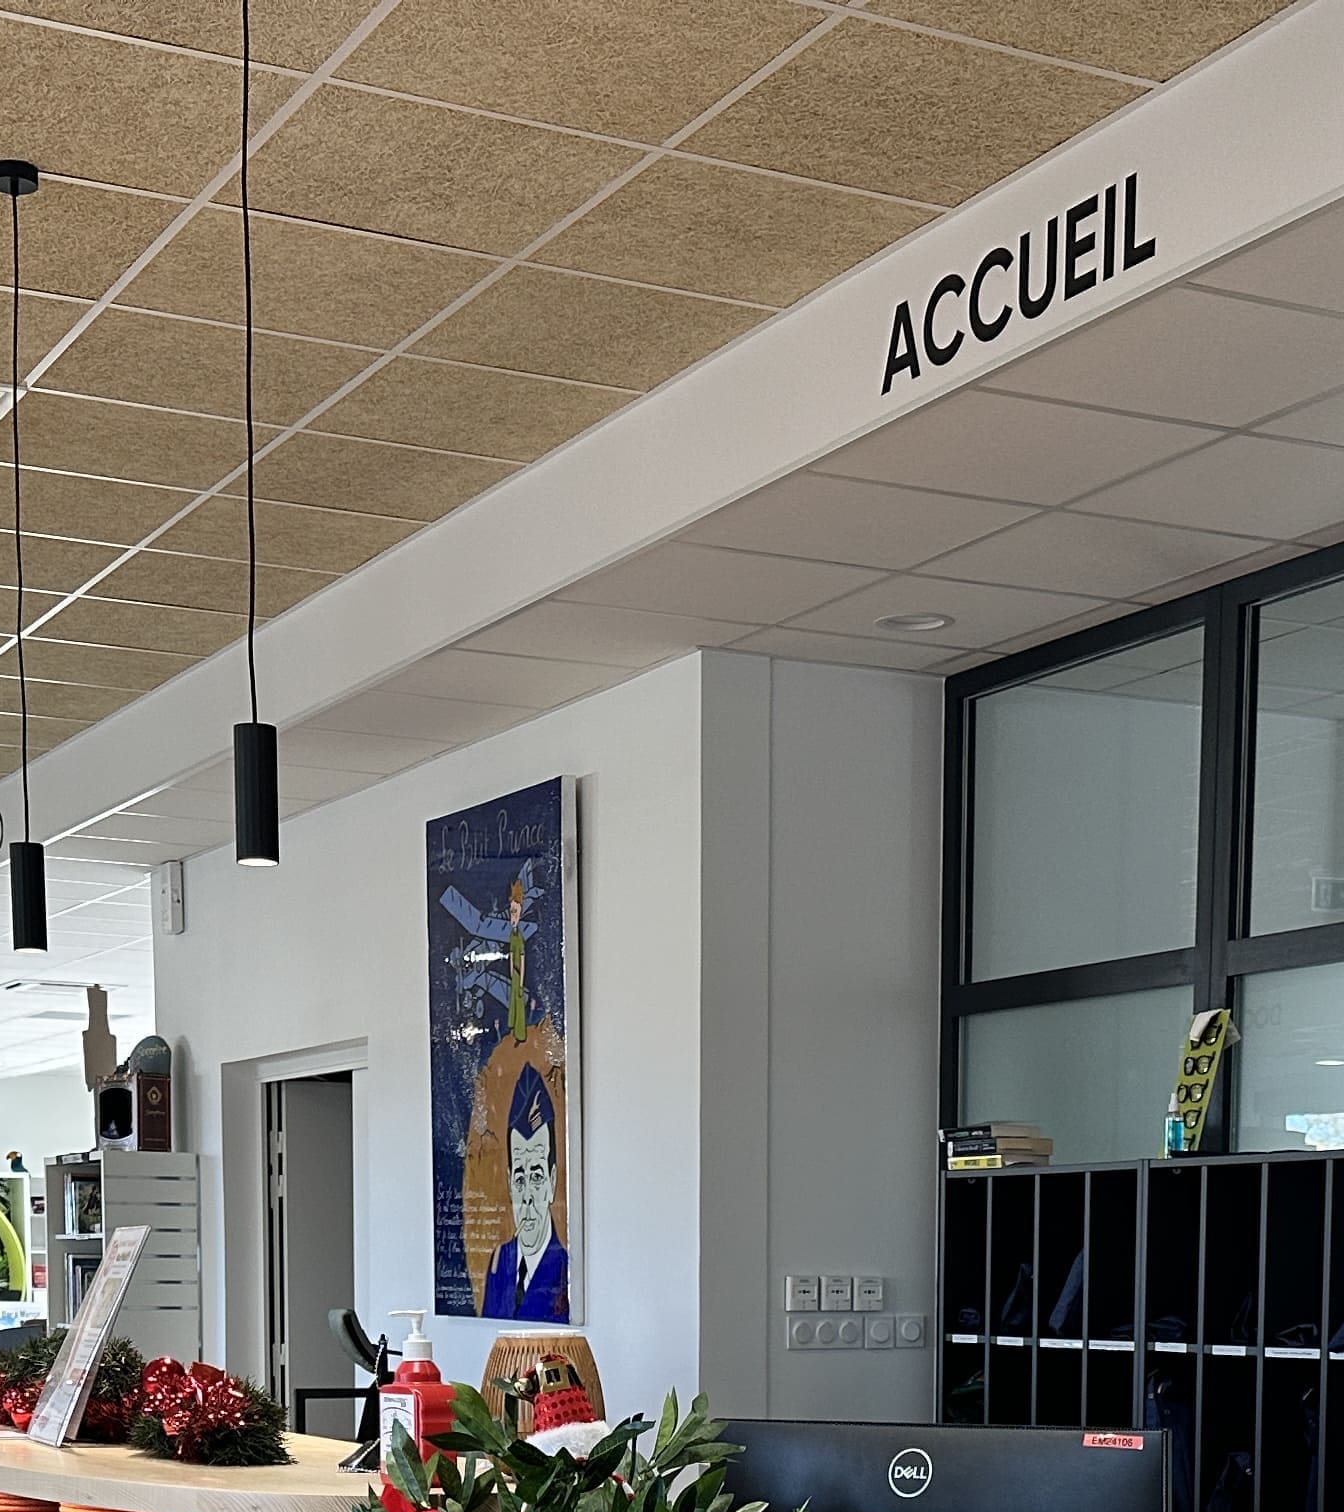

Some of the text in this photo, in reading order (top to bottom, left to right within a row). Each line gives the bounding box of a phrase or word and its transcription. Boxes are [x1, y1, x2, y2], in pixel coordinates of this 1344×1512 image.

[880, 171, 1156, 396] ACCUEIL
[439, 825, 455, 874] Le
[894, 1465, 927, 1480] DELL
